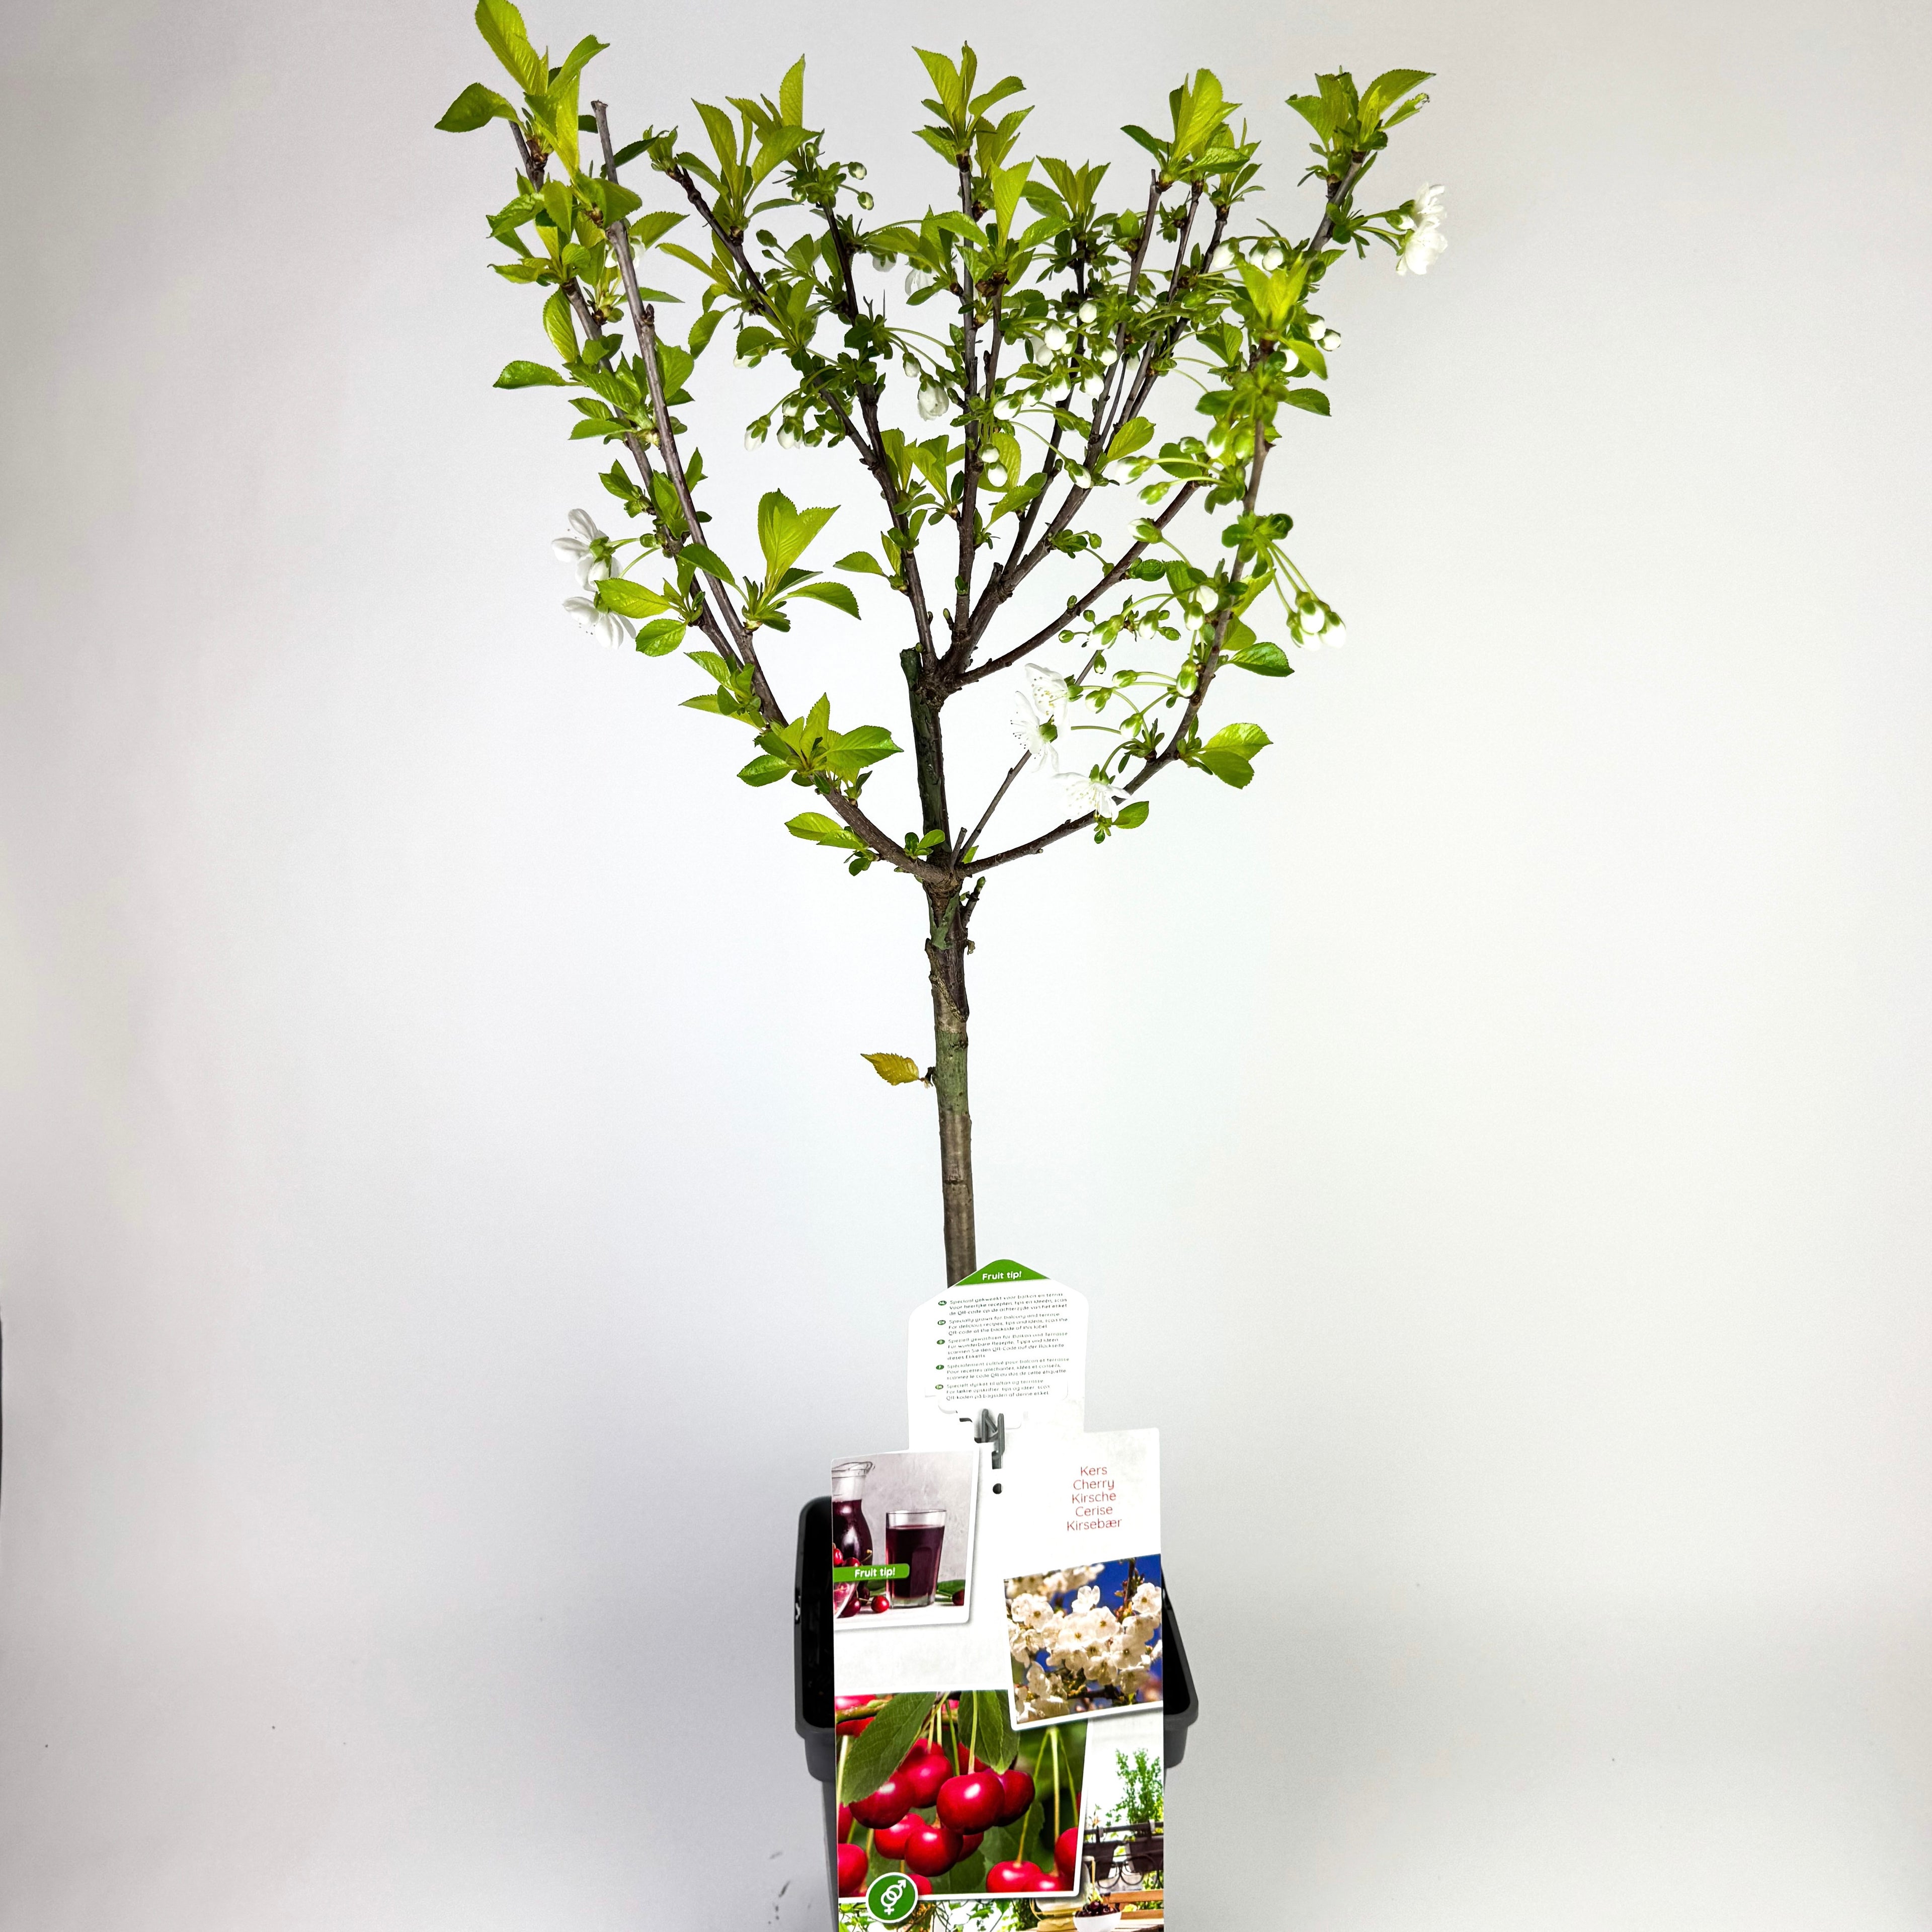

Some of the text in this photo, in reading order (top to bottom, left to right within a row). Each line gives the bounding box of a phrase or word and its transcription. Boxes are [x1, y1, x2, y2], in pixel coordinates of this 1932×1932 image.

[982, 1270, 1022, 1280] Fruit tip!
[1081, 1466, 1107, 1476] Kers
[1073, 1479, 1114, 1490] Cherry
[1072, 1491, 1116, 1504] Kirsche
[1076, 1506, 1113, 1516] Cerise
[1067, 1518, 1122, 1532] Kirsebær
[855, 1567, 896, 1578] Fruit tip!
